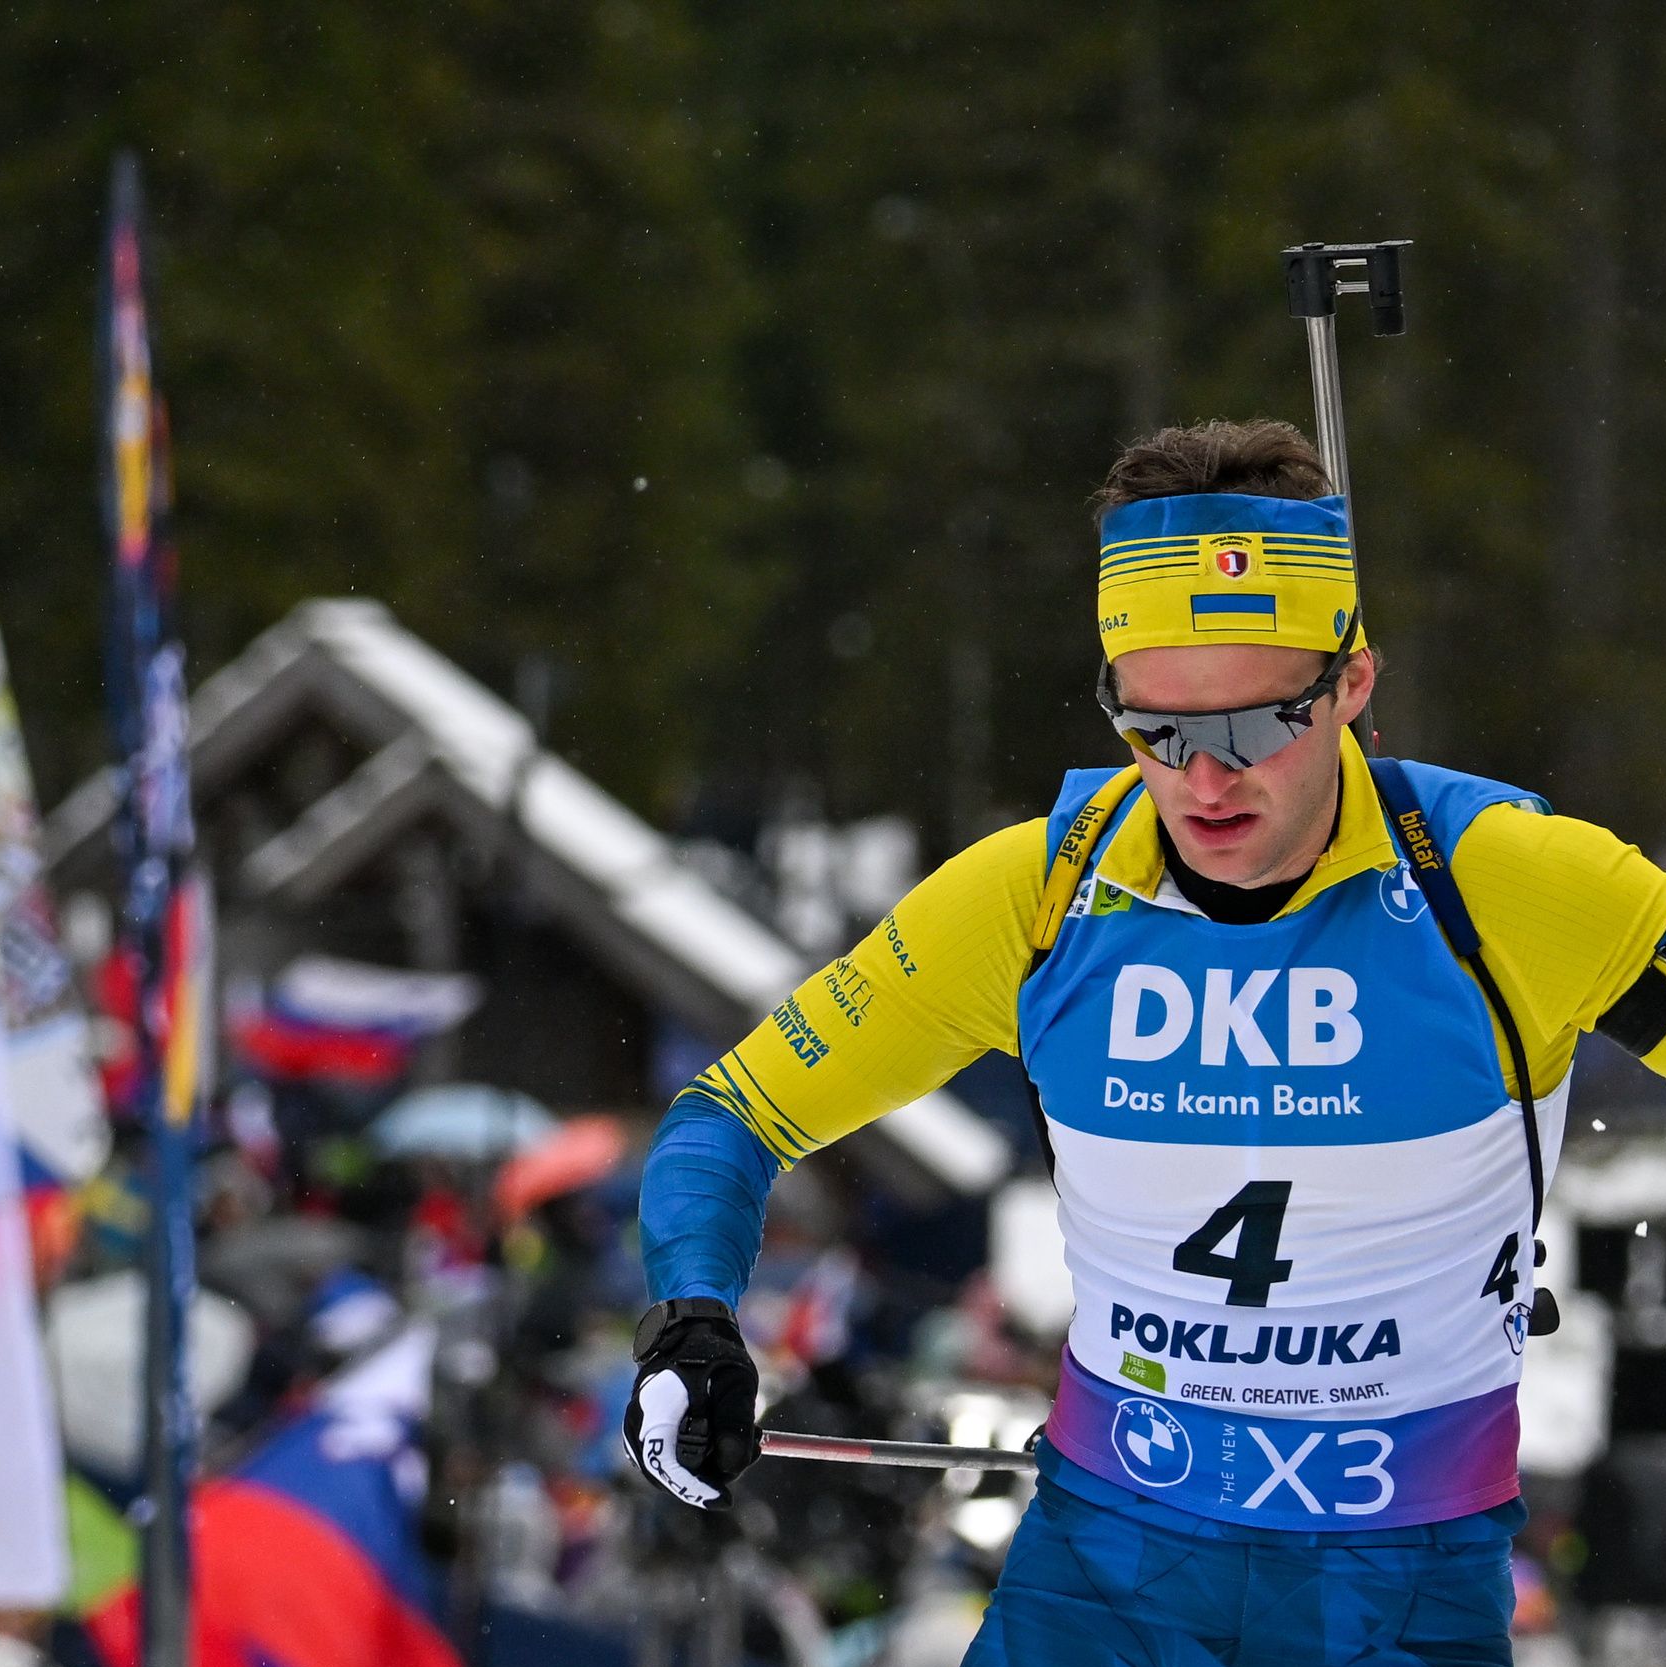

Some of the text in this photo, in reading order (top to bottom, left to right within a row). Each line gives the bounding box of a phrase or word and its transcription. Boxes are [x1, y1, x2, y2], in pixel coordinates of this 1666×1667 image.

[1224, 553, 1241, 573] 1
[1058, 805, 1106, 866] biatar
[1398, 809, 1439, 870] biatar
[823, 972, 863, 1028] resorts
[1107, 963, 1364, 1067] DKB
[1103, 1076, 1364, 1116] Das kann Bank
[1172, 1180, 1294, 1308] 4
[1480, 1231, 1520, 1306] 4
[1110, 1301, 1402, 1366] POKLJUKA
[1128, 1354, 1146, 1369] FEEL
[1180, 1382, 1390, 1405] GREEN. CREATIVE. SMART.
[647, 1437, 704, 1504] Roeckl
[1219, 1422, 1237, 1504] THE NEW
[1240, 1426, 1395, 1516] X3
